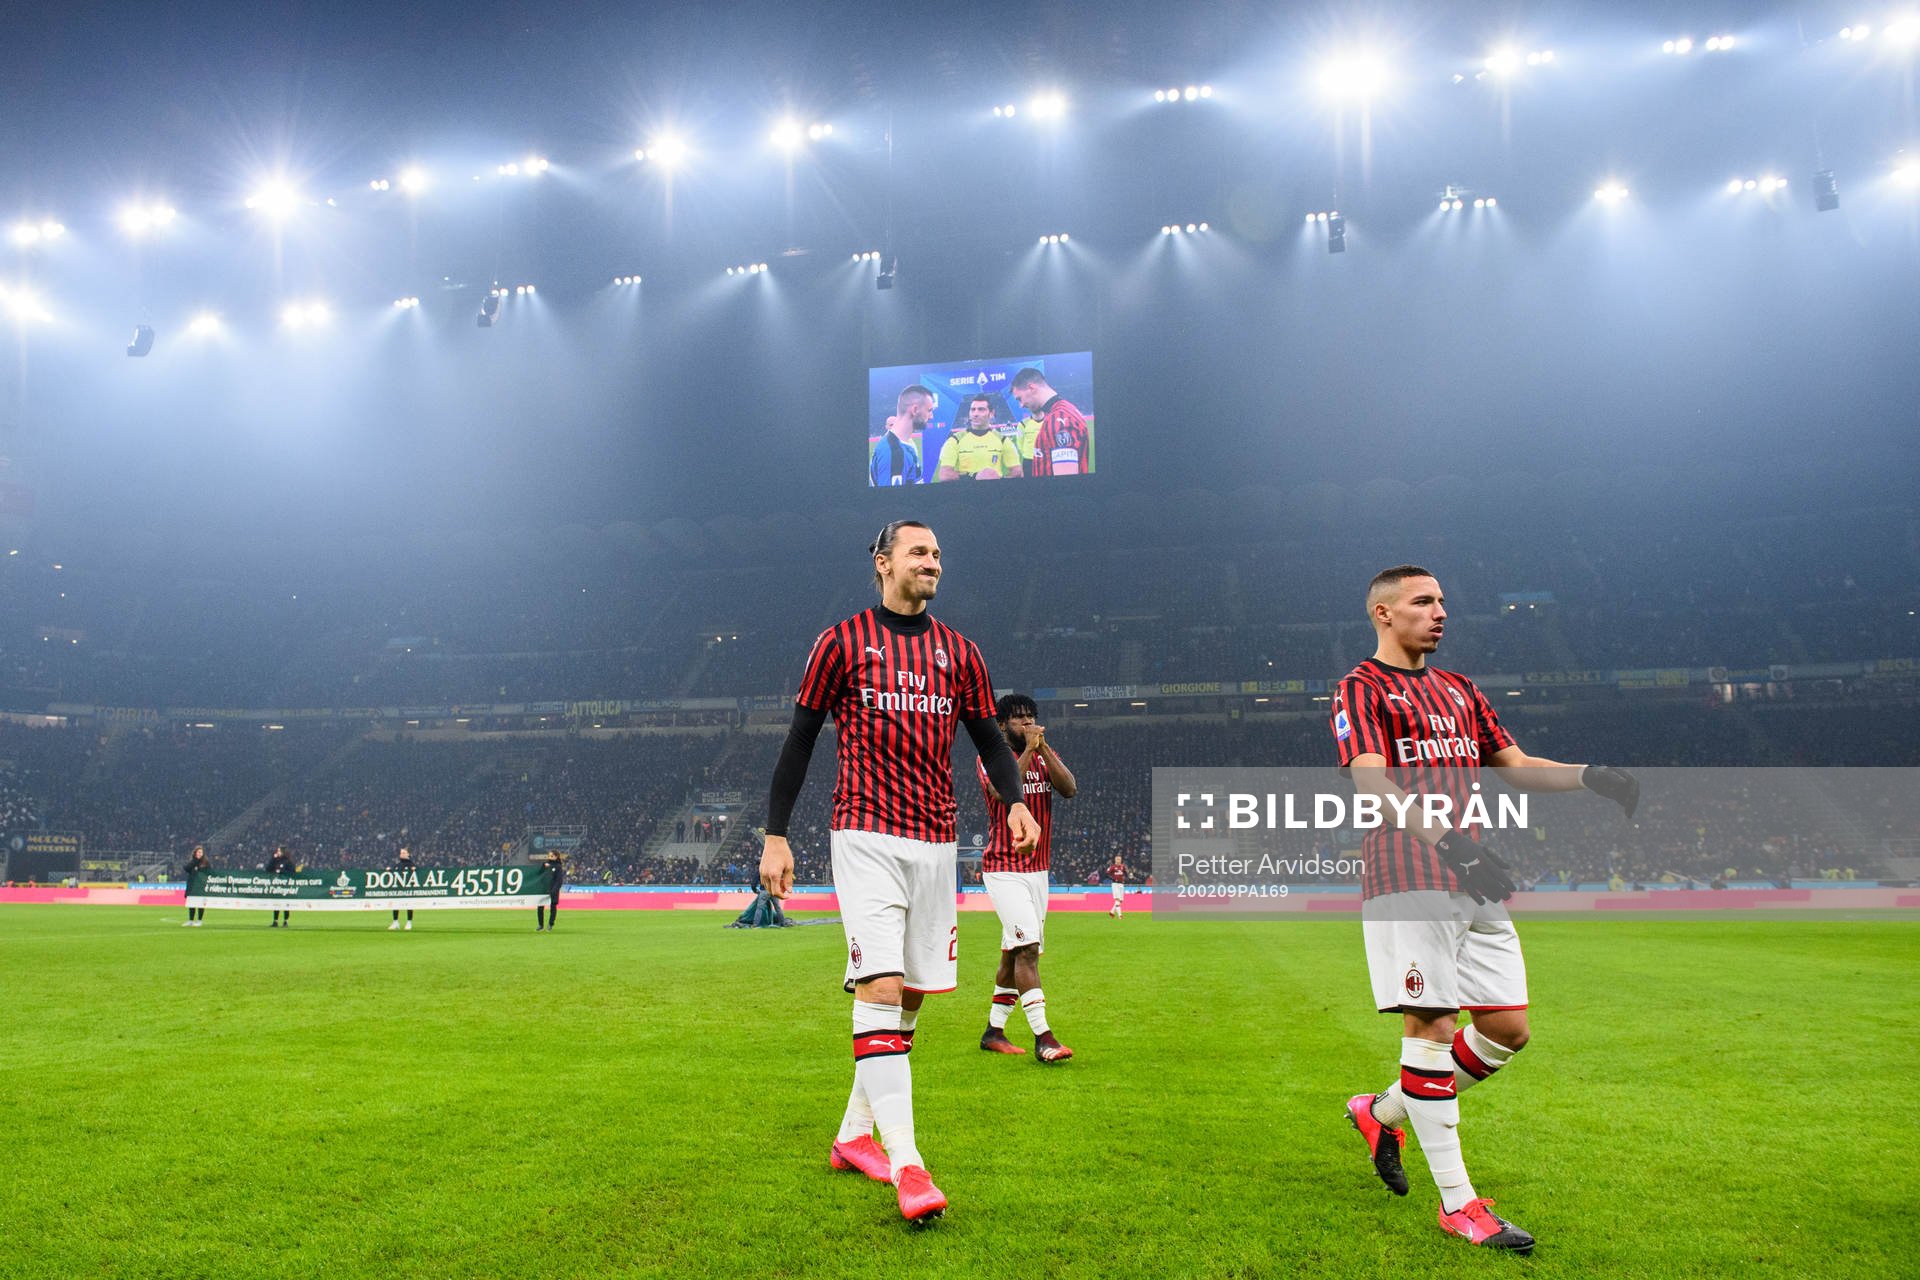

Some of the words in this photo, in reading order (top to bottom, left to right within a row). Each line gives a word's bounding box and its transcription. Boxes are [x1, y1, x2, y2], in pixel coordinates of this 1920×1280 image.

[950, 376, 975, 386] SERIE
[990, 373, 1006, 382] TIM
[897, 670, 926, 691] Fly
[1161, 682, 1220, 694] GIORGIONE
[861, 688, 953, 715] Emirates
[1428, 714, 1456, 733] Fly
[1395, 734, 1479, 763] Emirats
[1026, 770, 1040, 782] Fly
[272, 877, 288, 885] dove
[423, 870, 448, 887] AL
[450, 868, 523, 896] 45519
[209, 885, 226, 893] ridere
[238, 886, 263, 894] medicina
